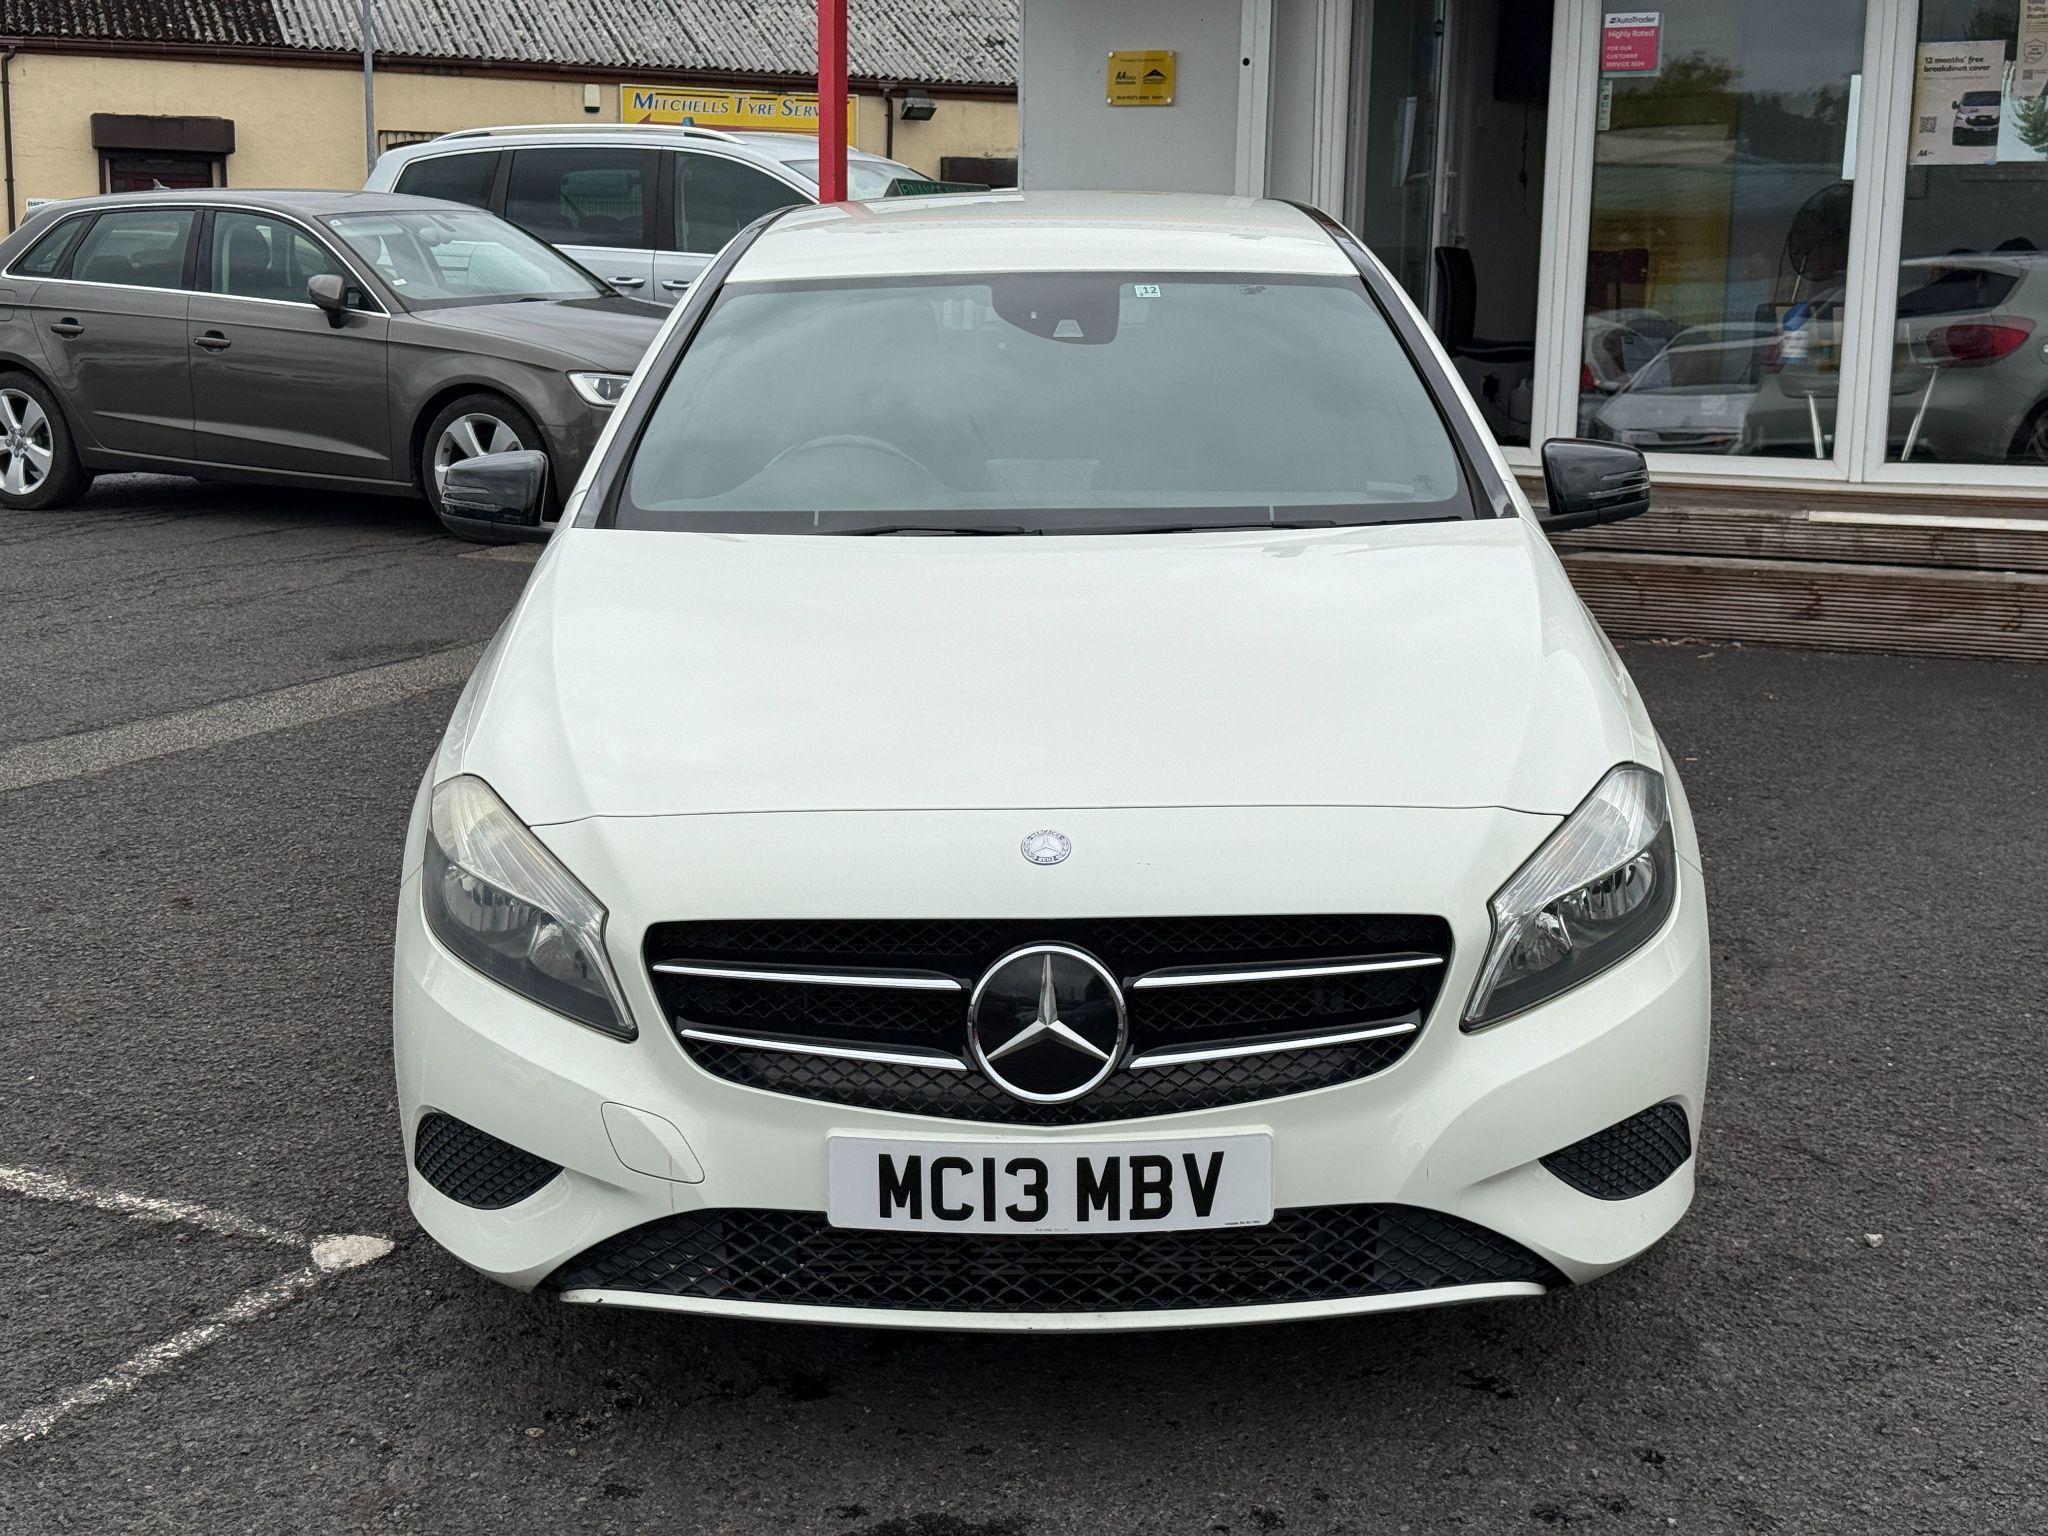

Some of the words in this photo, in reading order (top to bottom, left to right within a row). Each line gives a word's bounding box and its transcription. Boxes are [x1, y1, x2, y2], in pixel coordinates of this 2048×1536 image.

[1616, 16, 1656, 24] AutoTrader
[1608, 30, 1631, 39] Highly
[1968, 55, 1985, 65] free
[1923, 64, 1968, 73] breakdown
[633, 91, 729, 114] MITCHELLS
[734, 96, 775, 116] TYRE
[781, 98, 819, 117] SERV
[878, 1153, 1049, 1222] MC13
[1076, 1150, 1225, 1222] MBV
